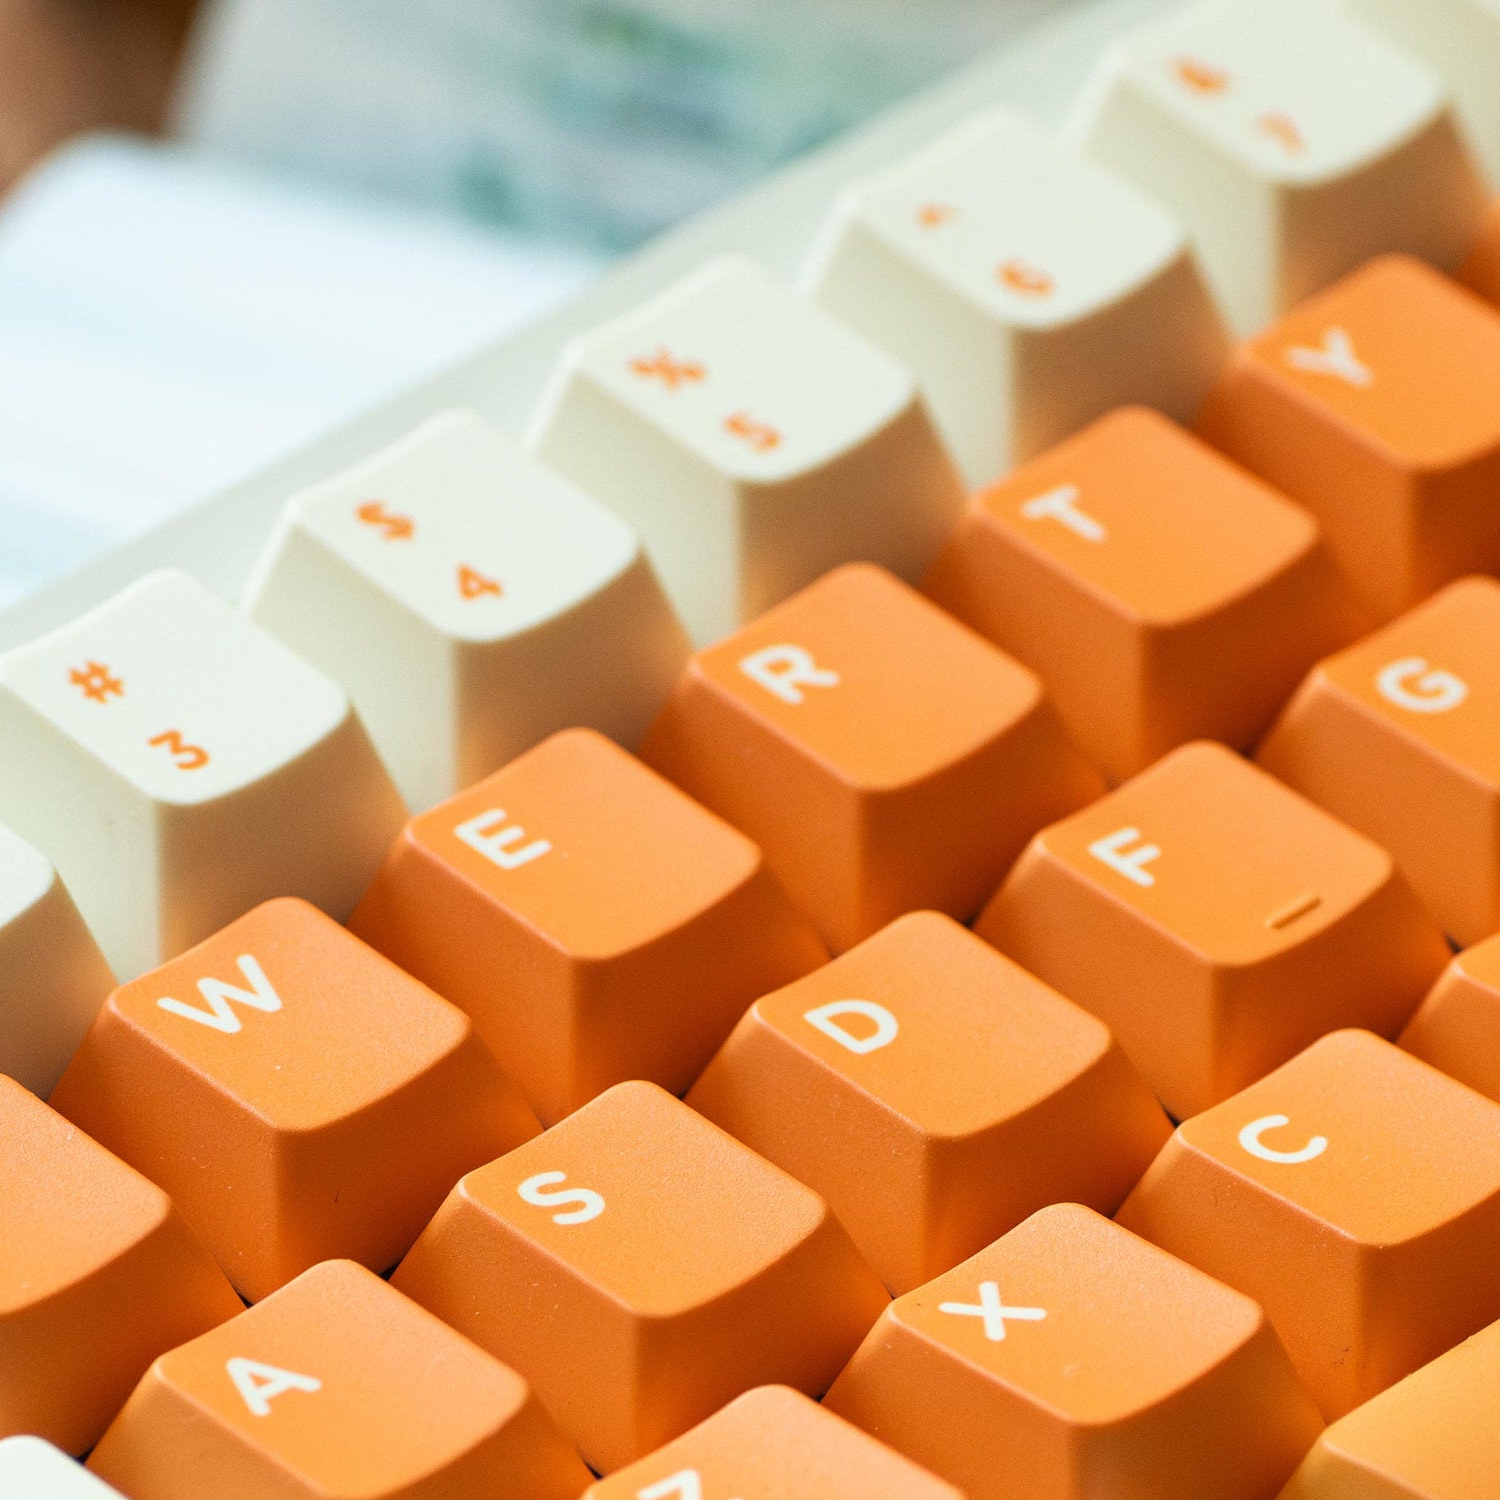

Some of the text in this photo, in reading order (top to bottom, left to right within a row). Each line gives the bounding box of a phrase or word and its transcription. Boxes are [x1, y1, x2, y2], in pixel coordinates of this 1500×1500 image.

[1289, 329, 1371, 385] Y
[357, 503, 414, 540] $
[1023, 486, 1105, 541] T
[457, 565, 502, 600] 4
[70, 662, 123, 703] #
[740, 645, 839, 704] R
[1377, 659, 1467, 712] G
[149, 730, 210, 771] 3
[455, 809, 552, 869] E
[1089, 828, 1160, 886] F
[156, 953, 283, 1034] W
[804, 1000, 899, 1055] D
[1238, 1114, 1328, 1164] C
[518, 1171, 606, 1225] S
[939, 1280, 1047, 1341] X
[226, 1357, 322, 1416] A
